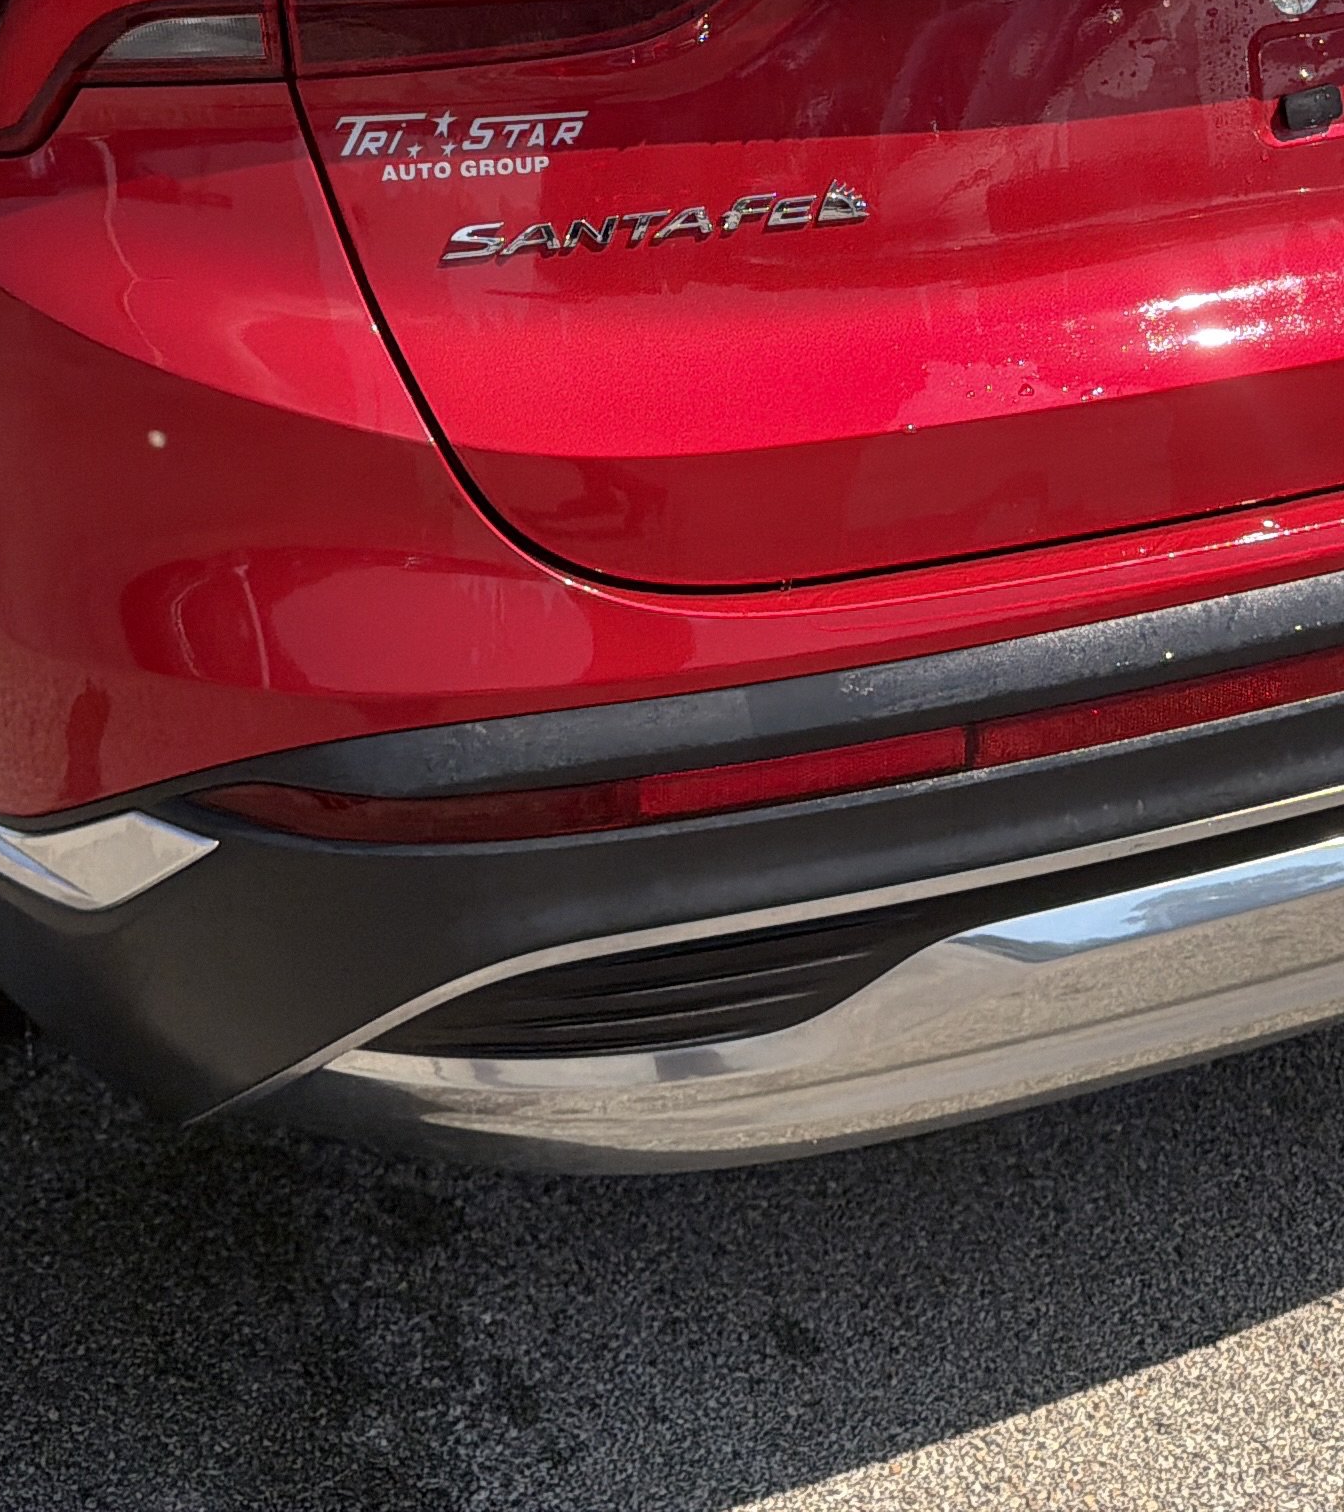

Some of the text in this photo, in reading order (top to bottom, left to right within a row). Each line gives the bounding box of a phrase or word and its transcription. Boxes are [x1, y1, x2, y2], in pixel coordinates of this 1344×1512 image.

[461, 110, 590, 151] STAR
[381, 155, 551, 182] AUTO GROUP
